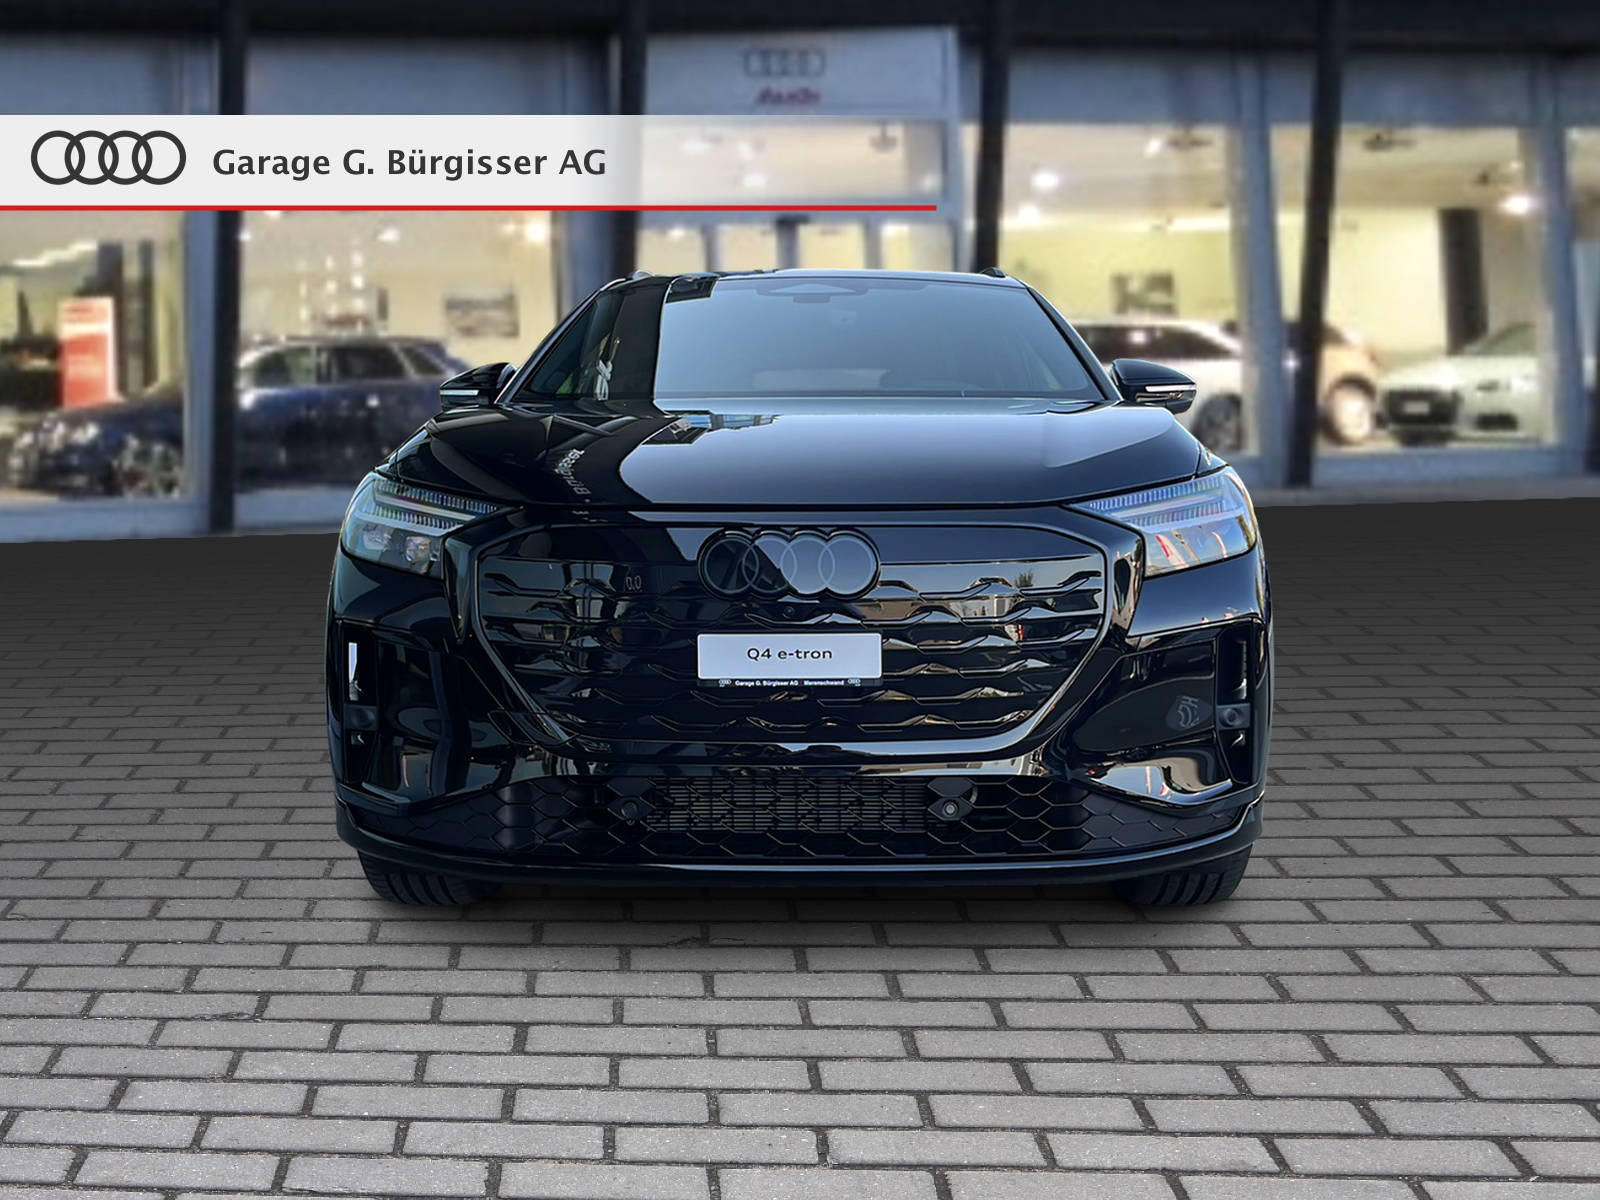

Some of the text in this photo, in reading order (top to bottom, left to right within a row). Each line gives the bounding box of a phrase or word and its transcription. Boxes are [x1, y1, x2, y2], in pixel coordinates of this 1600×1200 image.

[747, 647, 833, 661] Q4 e-tron
[734, 679, 755, 688] Garage
